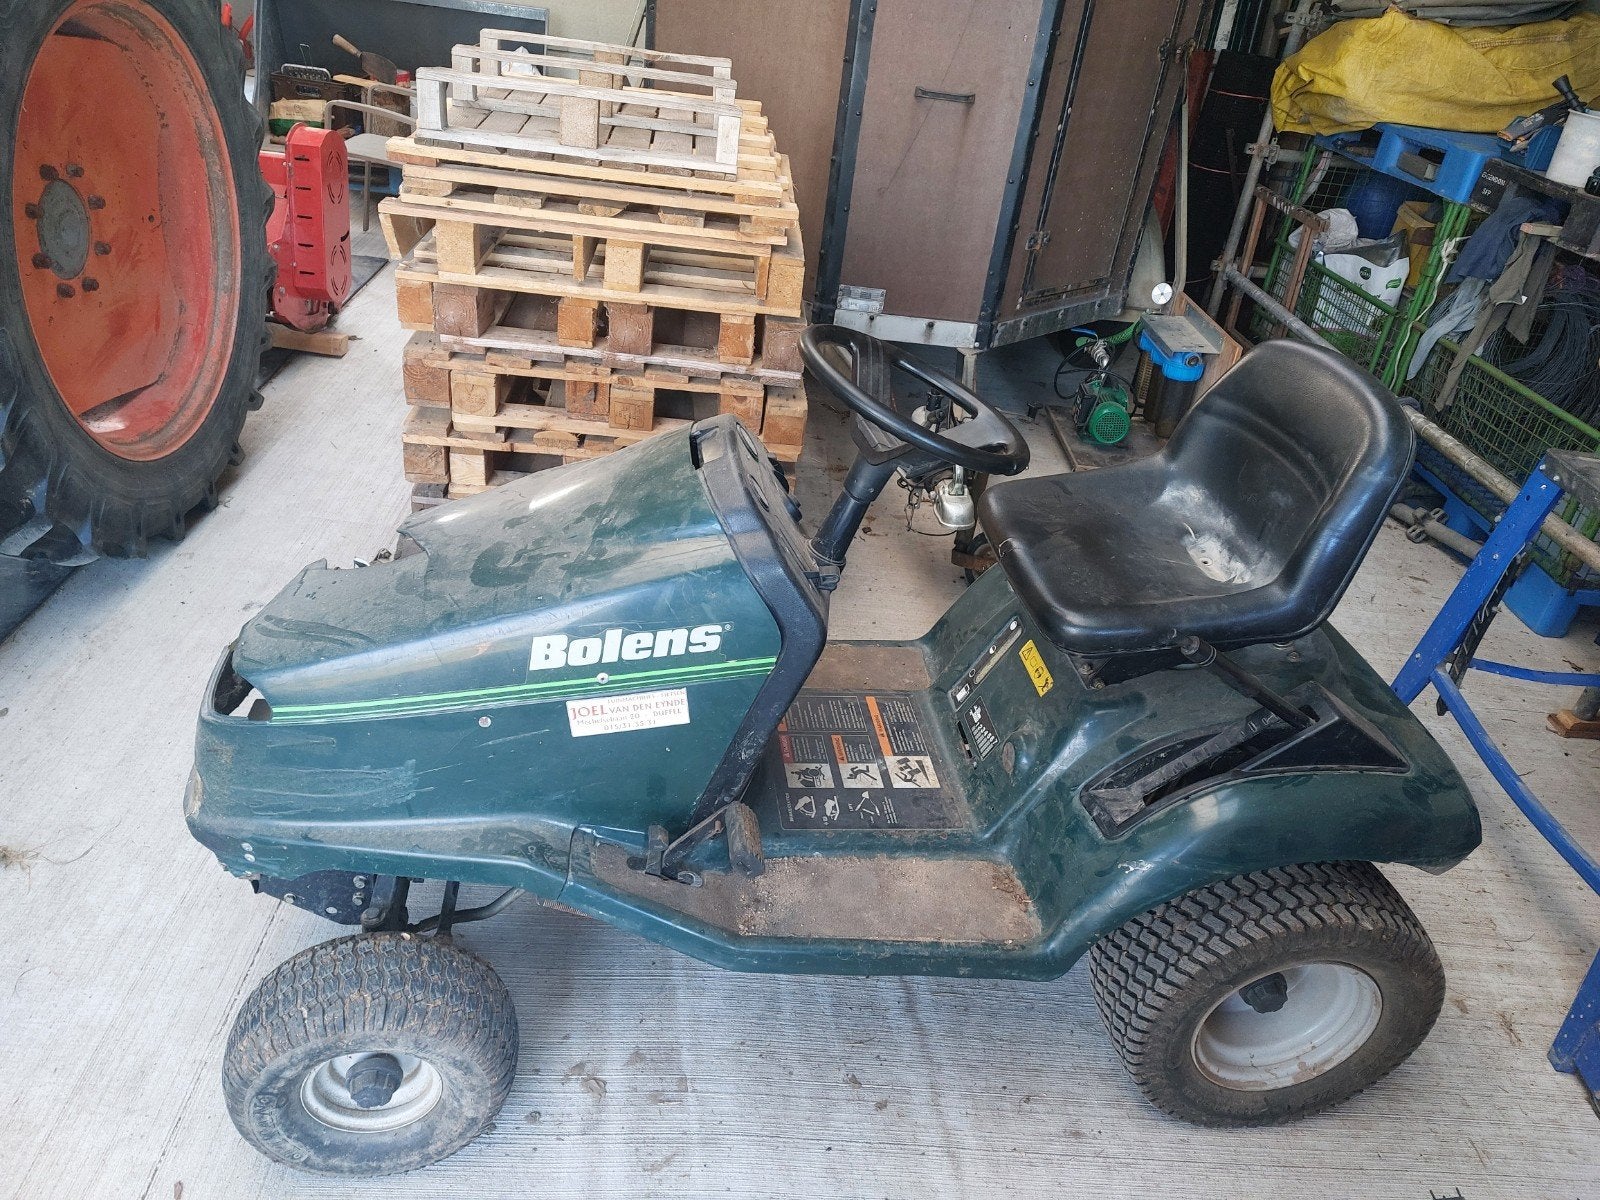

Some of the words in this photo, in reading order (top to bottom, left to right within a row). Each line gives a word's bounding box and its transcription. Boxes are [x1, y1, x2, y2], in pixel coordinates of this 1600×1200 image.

[529, 624, 723, 671] Bolens
[570, 704, 608, 720] JOEL
[608, 705, 630, 714] VAN
[633, 703, 652, 712] DEN
[655, 698, 686, 709] EYNDE
[653, 708, 682, 718] DUFFEL
